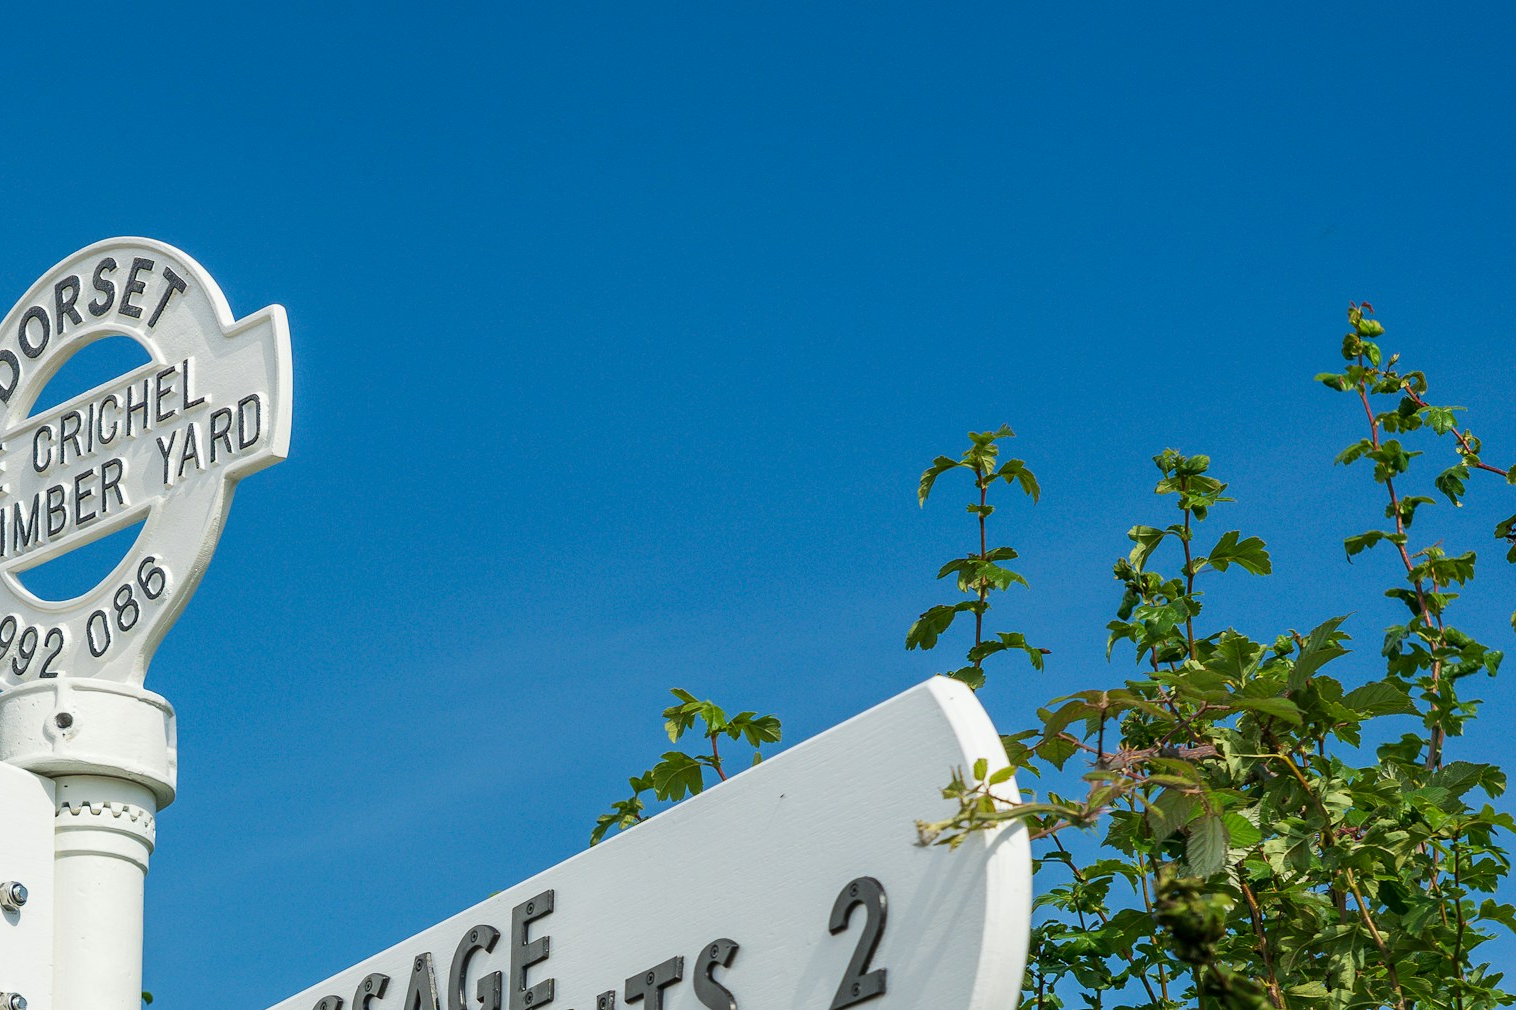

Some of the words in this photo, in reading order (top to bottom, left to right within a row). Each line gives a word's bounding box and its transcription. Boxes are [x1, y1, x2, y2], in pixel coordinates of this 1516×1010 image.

[32, 359, 206, 474] CRICHEL
[156, 393, 262, 486] YARD
[86, 556, 167, 659] 086
